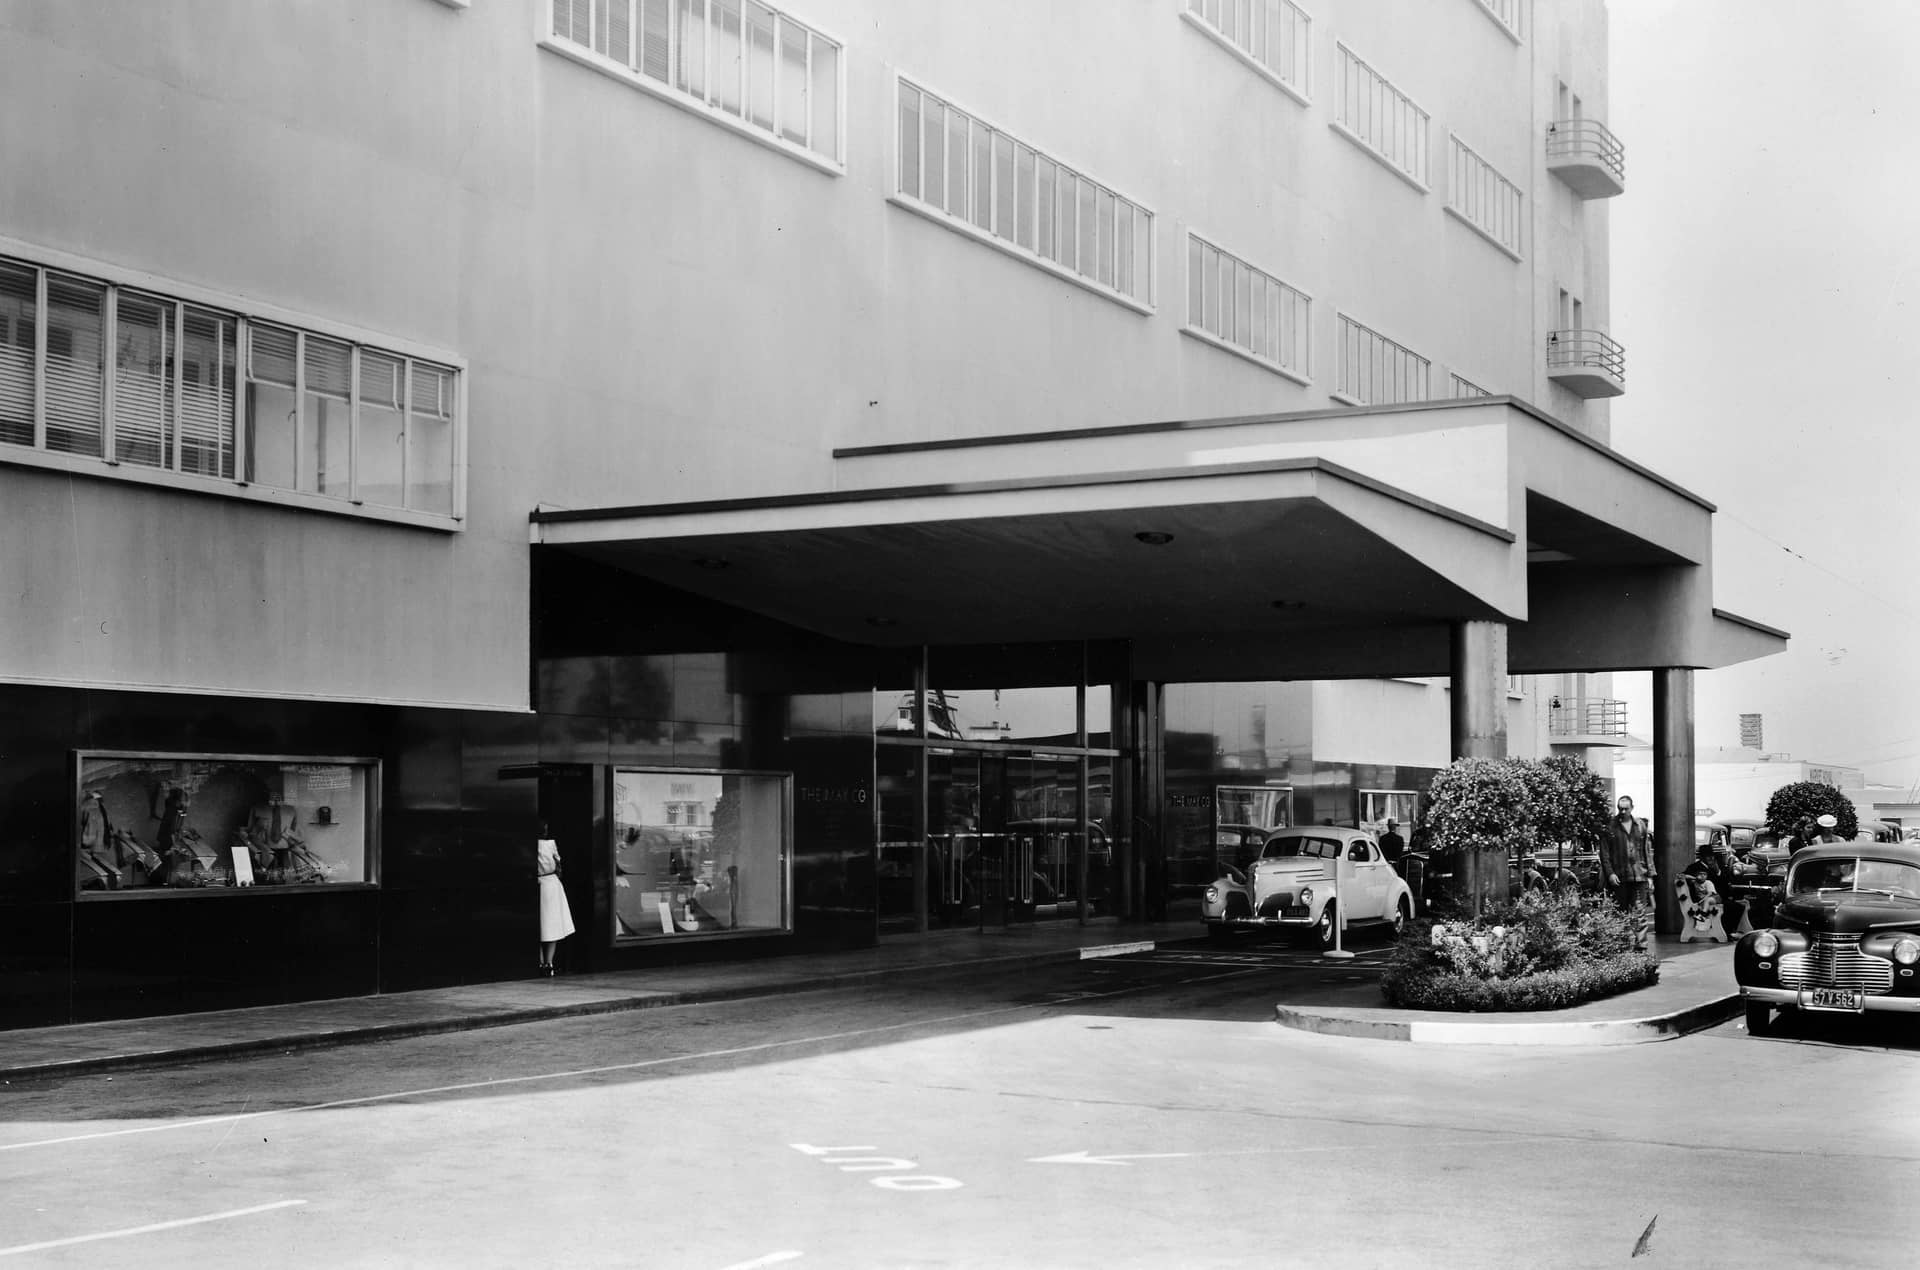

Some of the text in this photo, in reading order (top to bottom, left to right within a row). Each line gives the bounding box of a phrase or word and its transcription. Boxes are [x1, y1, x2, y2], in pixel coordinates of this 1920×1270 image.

[799, 787, 821, 802] THE
[1814, 991, 1825, 1005] 57
[1835, 993, 1854, 1006] 562
[787, 1142, 964, 1191] OUT
